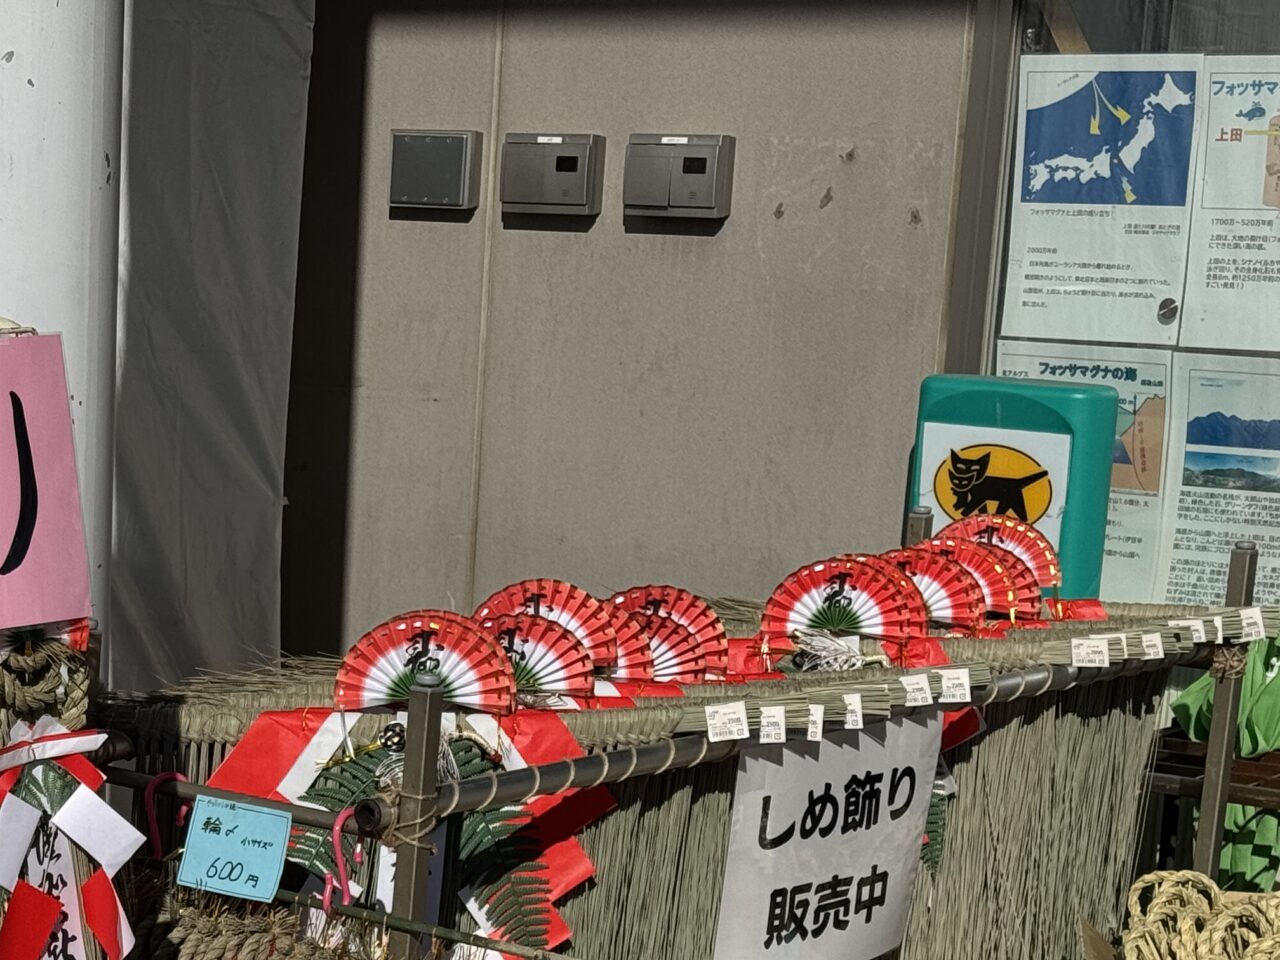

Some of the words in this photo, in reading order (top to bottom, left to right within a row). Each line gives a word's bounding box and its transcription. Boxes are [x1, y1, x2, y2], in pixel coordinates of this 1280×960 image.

[1211, 80, 1280, 96] フォッサマ
[1214, 127, 1243, 142] 上田
[758, 766, 916, 850] しめ飾り
[206, 857, 259, 888] 600円
[763, 864, 889, 950] 販売中
